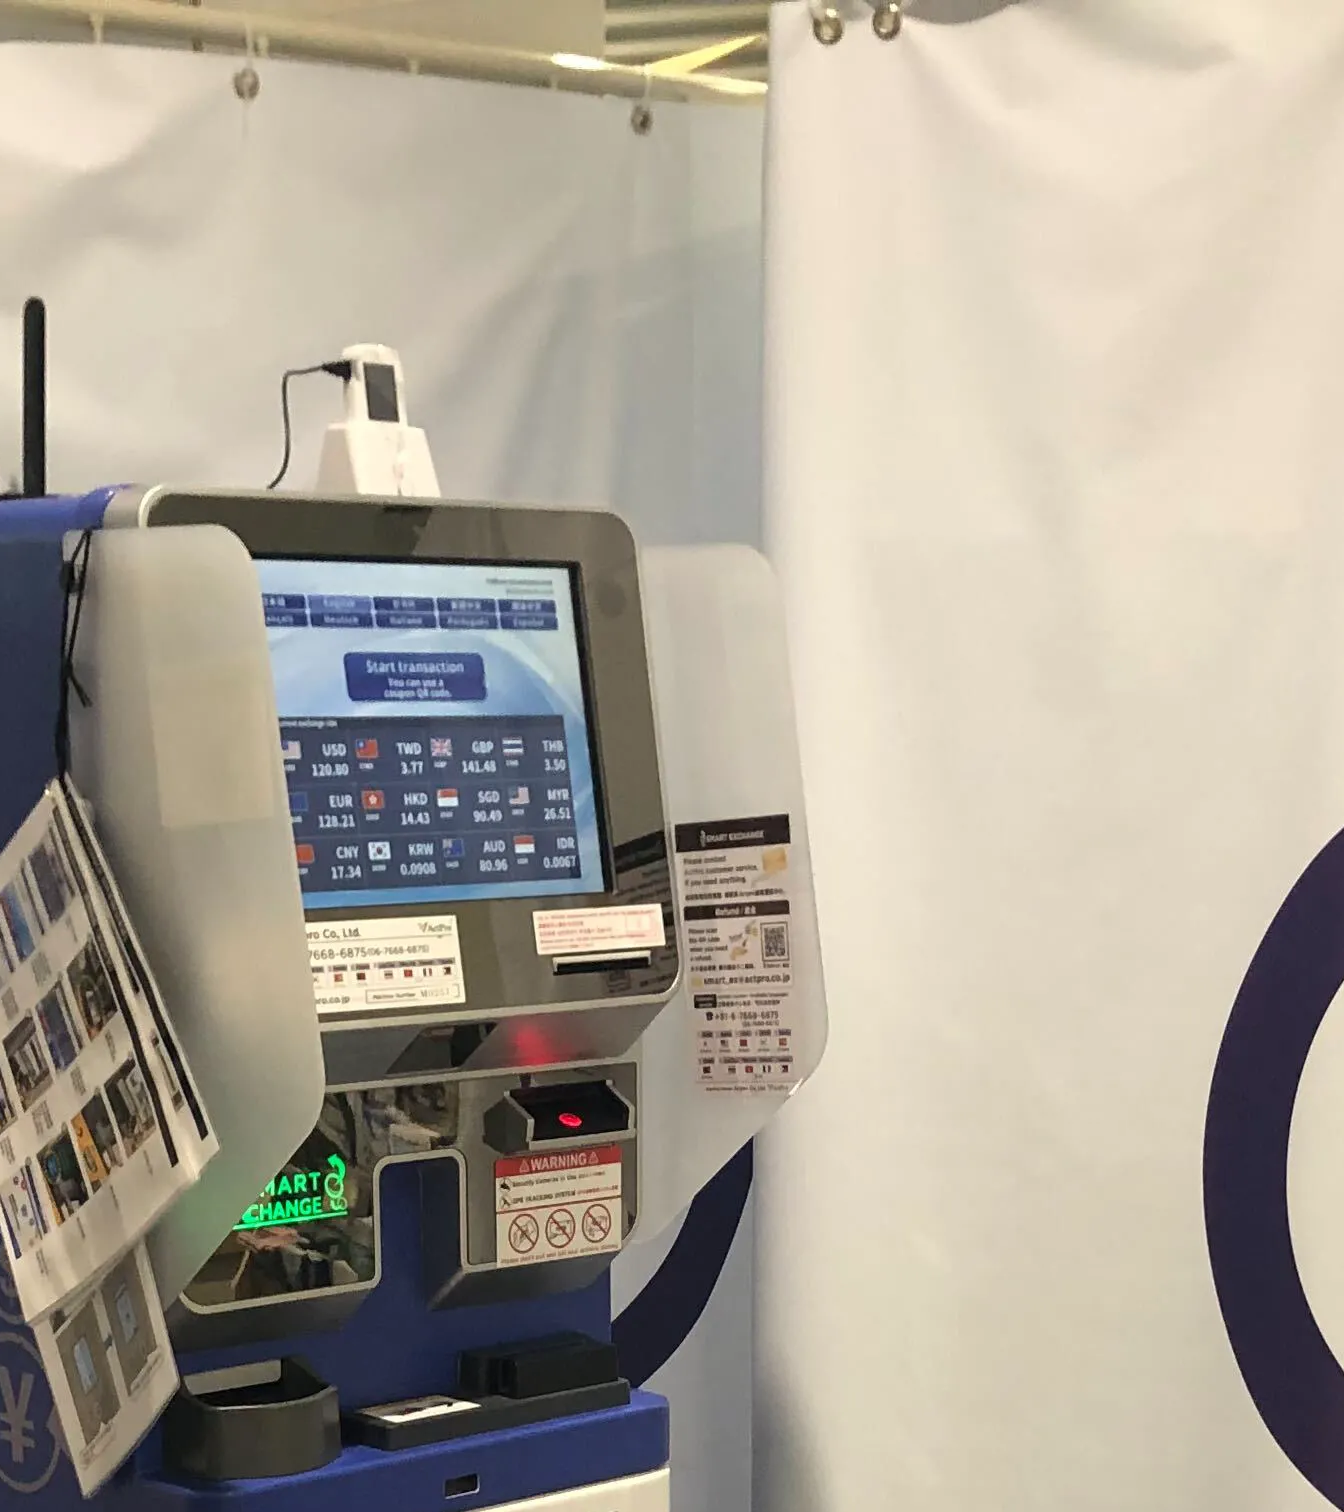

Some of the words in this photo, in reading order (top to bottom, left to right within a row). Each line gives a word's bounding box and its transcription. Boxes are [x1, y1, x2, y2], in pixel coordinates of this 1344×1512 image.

[366, 659, 396, 673] Start
[398, 661, 465, 673] transaction
[322, 743, 347, 757] USD
[396, 742, 422, 755] TWD
[471, 740, 494, 754] GBP
[542, 739, 564, 753] THB
[400, 761, 423, 775] 3.77
[461, 760, 497, 773] 141.48
[403, 792, 429, 805] HKD
[477, 790, 501, 803] SGD
[547, 788, 570, 801] MYR
[328, 795, 353, 808] EUR
[400, 812, 430, 826] 14.43
[543, 807, 572, 820] 26.51
[483, 840, 506, 853] AUD
[556, 836, 575, 849] IDR
[335, 846, 359, 859] CNY
[408, 843, 434, 856] KRW
[330, 865, 362, 880] 17.34
[531, 1151, 587, 1171] WARNING
[241, 1196, 323, 1224] CHANGE
